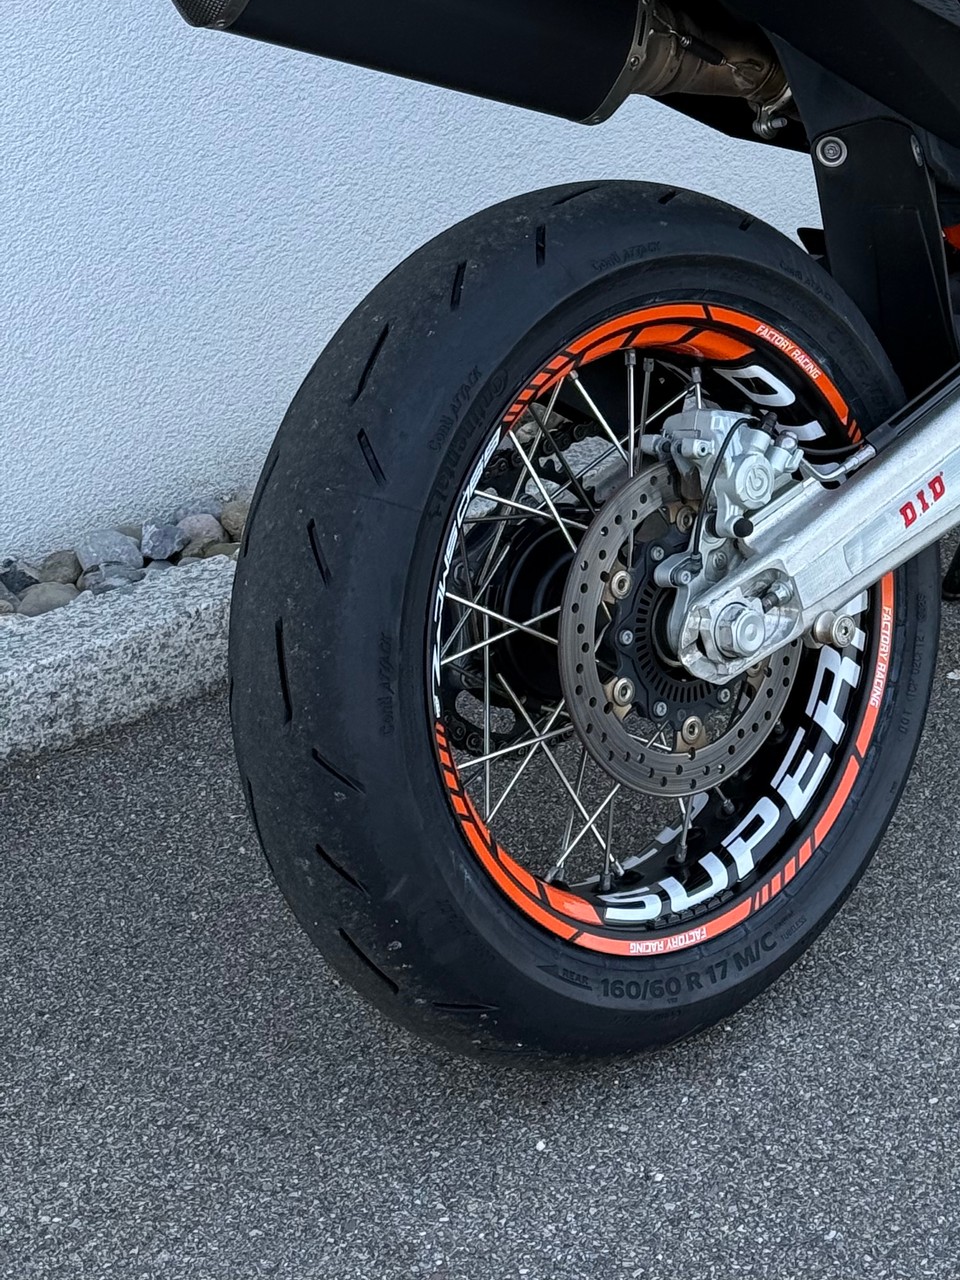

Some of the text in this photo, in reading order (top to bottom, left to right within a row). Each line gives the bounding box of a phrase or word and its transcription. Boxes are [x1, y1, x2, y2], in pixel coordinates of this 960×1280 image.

[755, 324, 822, 380] FACTORY RACING
[869, 606, 893, 709] FACTORY RACING
[596, 645, 862, 920] SUPER
[601, 976, 681, 1001] 160/60
[687, 971, 704, 993] R
[709, 959, 729, 986] 17
[733, 931, 778, 972] M/C
[629, 927, 707, 954] FACTORY RACING
